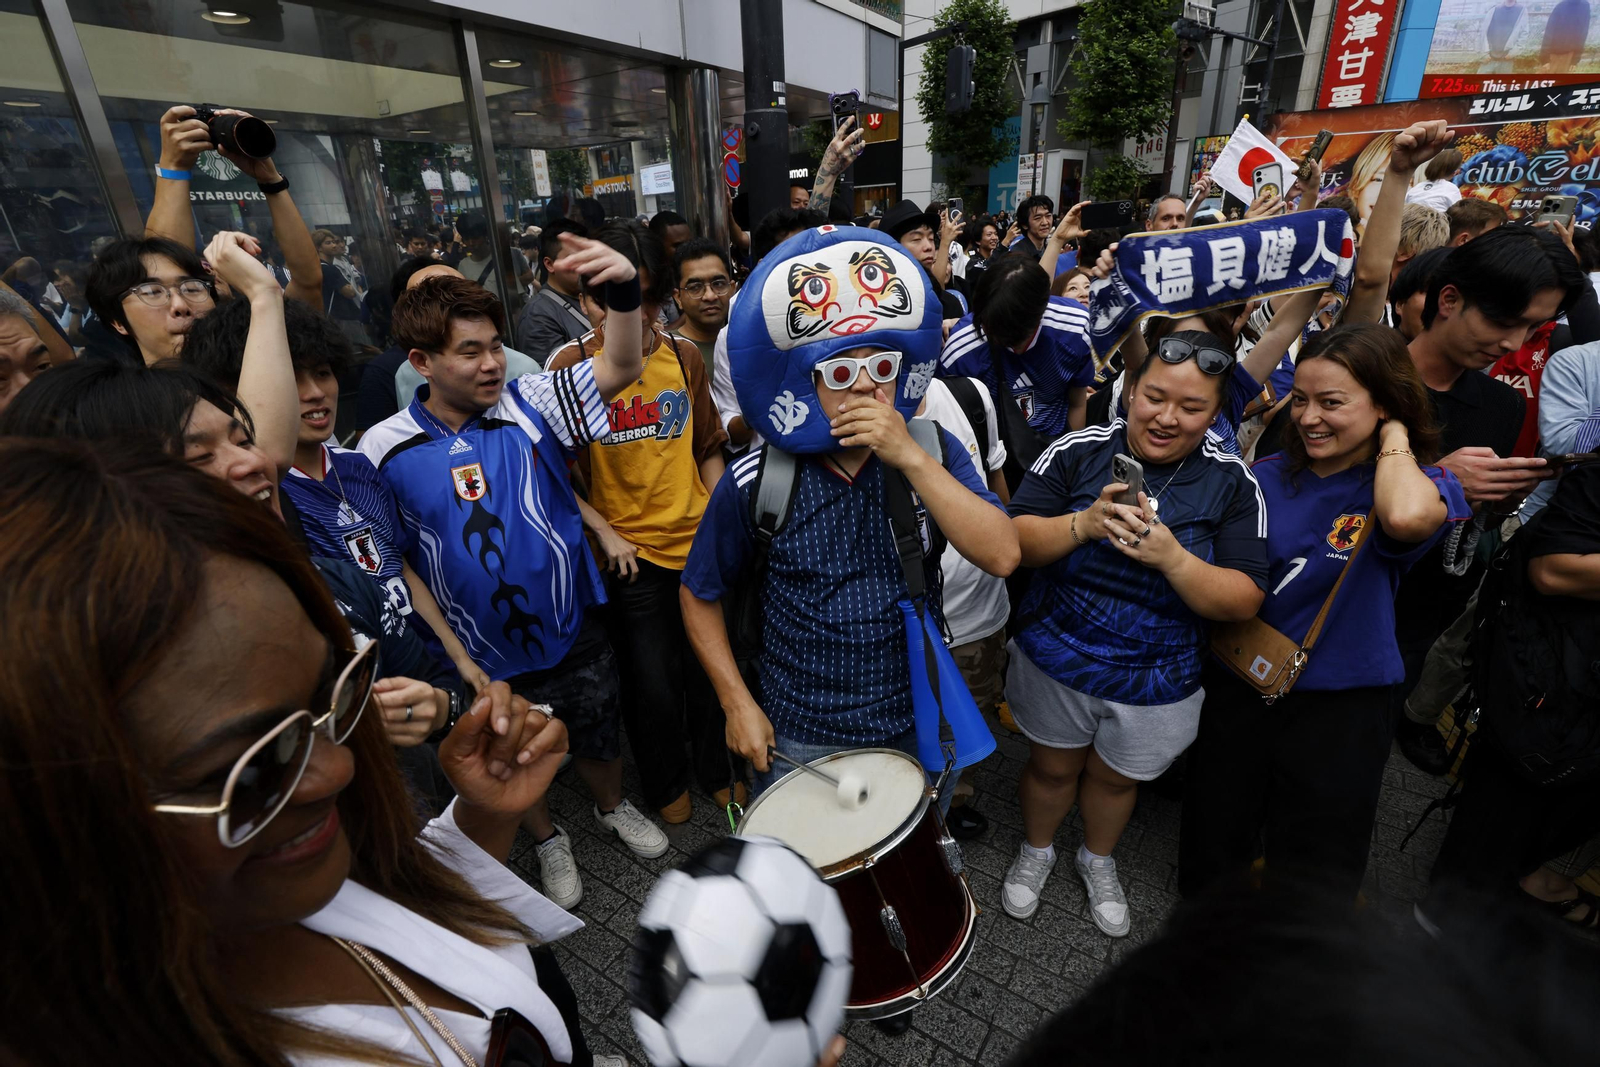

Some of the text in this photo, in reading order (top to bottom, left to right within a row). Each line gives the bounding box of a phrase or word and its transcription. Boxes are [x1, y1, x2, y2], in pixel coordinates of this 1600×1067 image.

[1431, 78, 1464, 93] 7.25
[1464, 84, 1479, 93] SAT
[1482, 79, 1507, 93] This
[1510, 79, 1521, 91] is
[1468, 94, 1535, 114] エルコレ
[1464, 160, 1524, 185] club
[189, 191, 267, 201] STARBUCKS
[1511, 199, 1542, 209] エルコ
[1141, 220, 1339, 304] 塩貝健人
[449, 445, 473, 456] adidas
[1326, 552, 1349, 561] JAPAN
